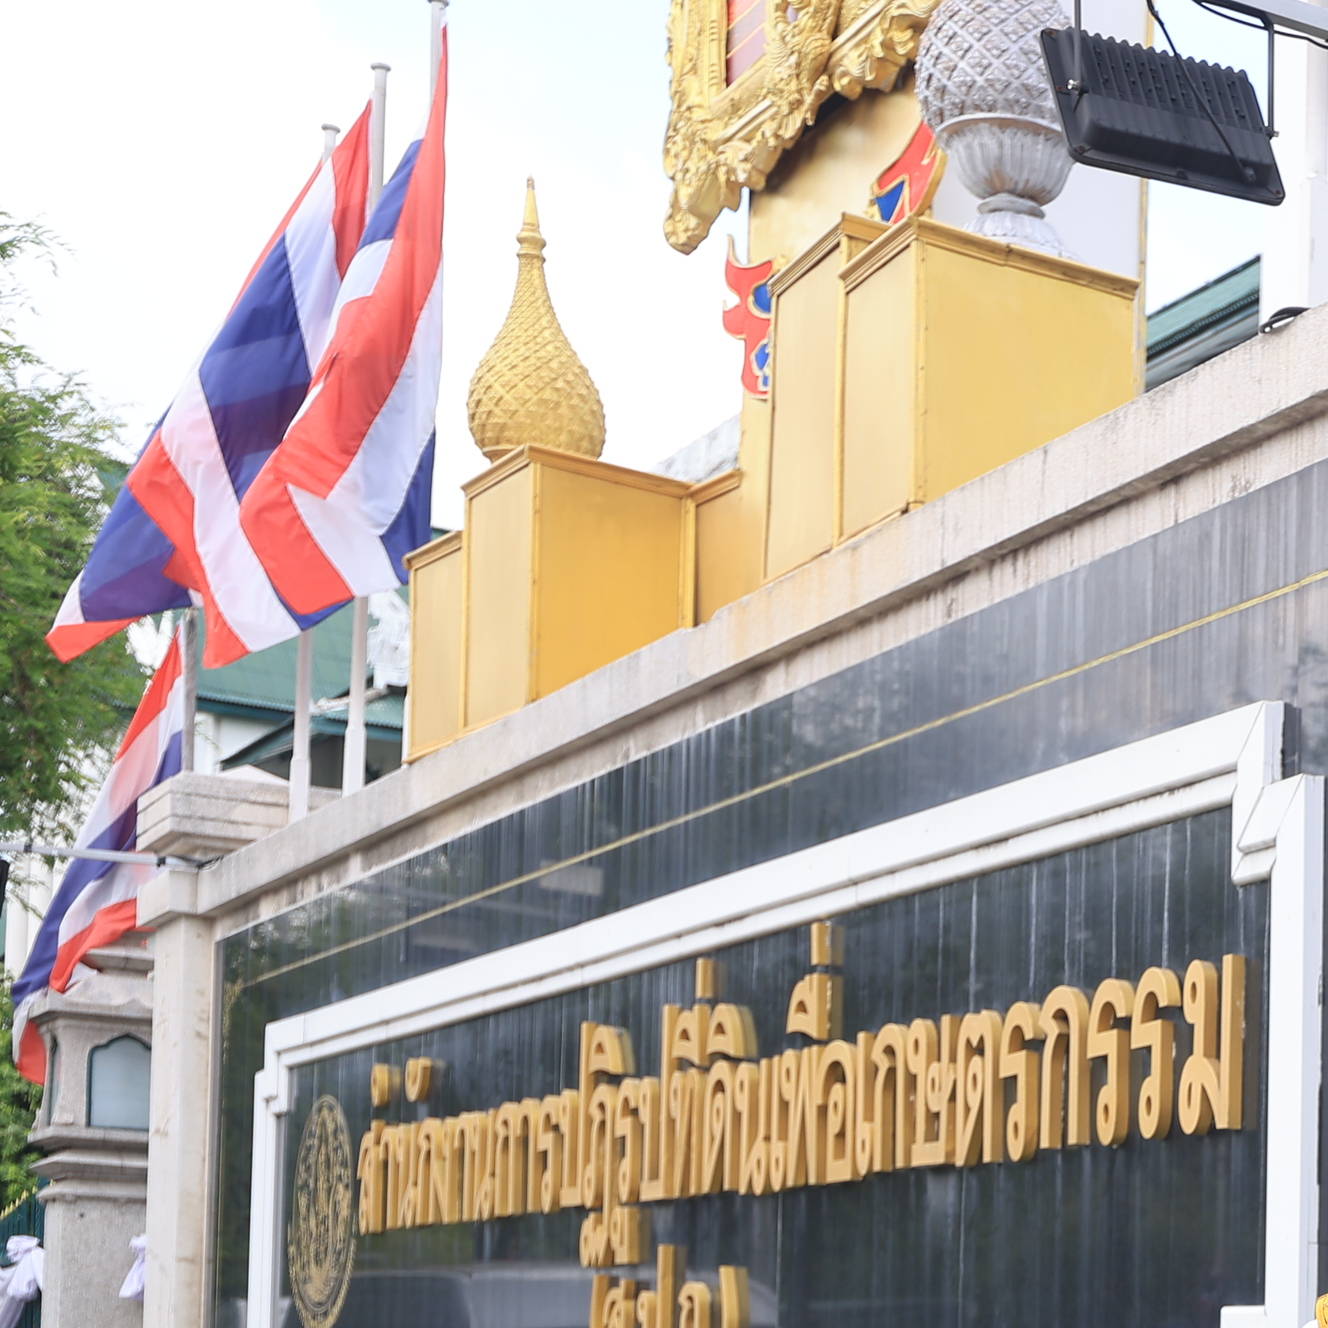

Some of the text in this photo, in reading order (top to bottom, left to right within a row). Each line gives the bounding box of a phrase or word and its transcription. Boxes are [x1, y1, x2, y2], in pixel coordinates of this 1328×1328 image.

[356, 921, 1246, 1268] สำนักงานการปฏิรูปที่ดินเพื่อเกษตรกรรม
